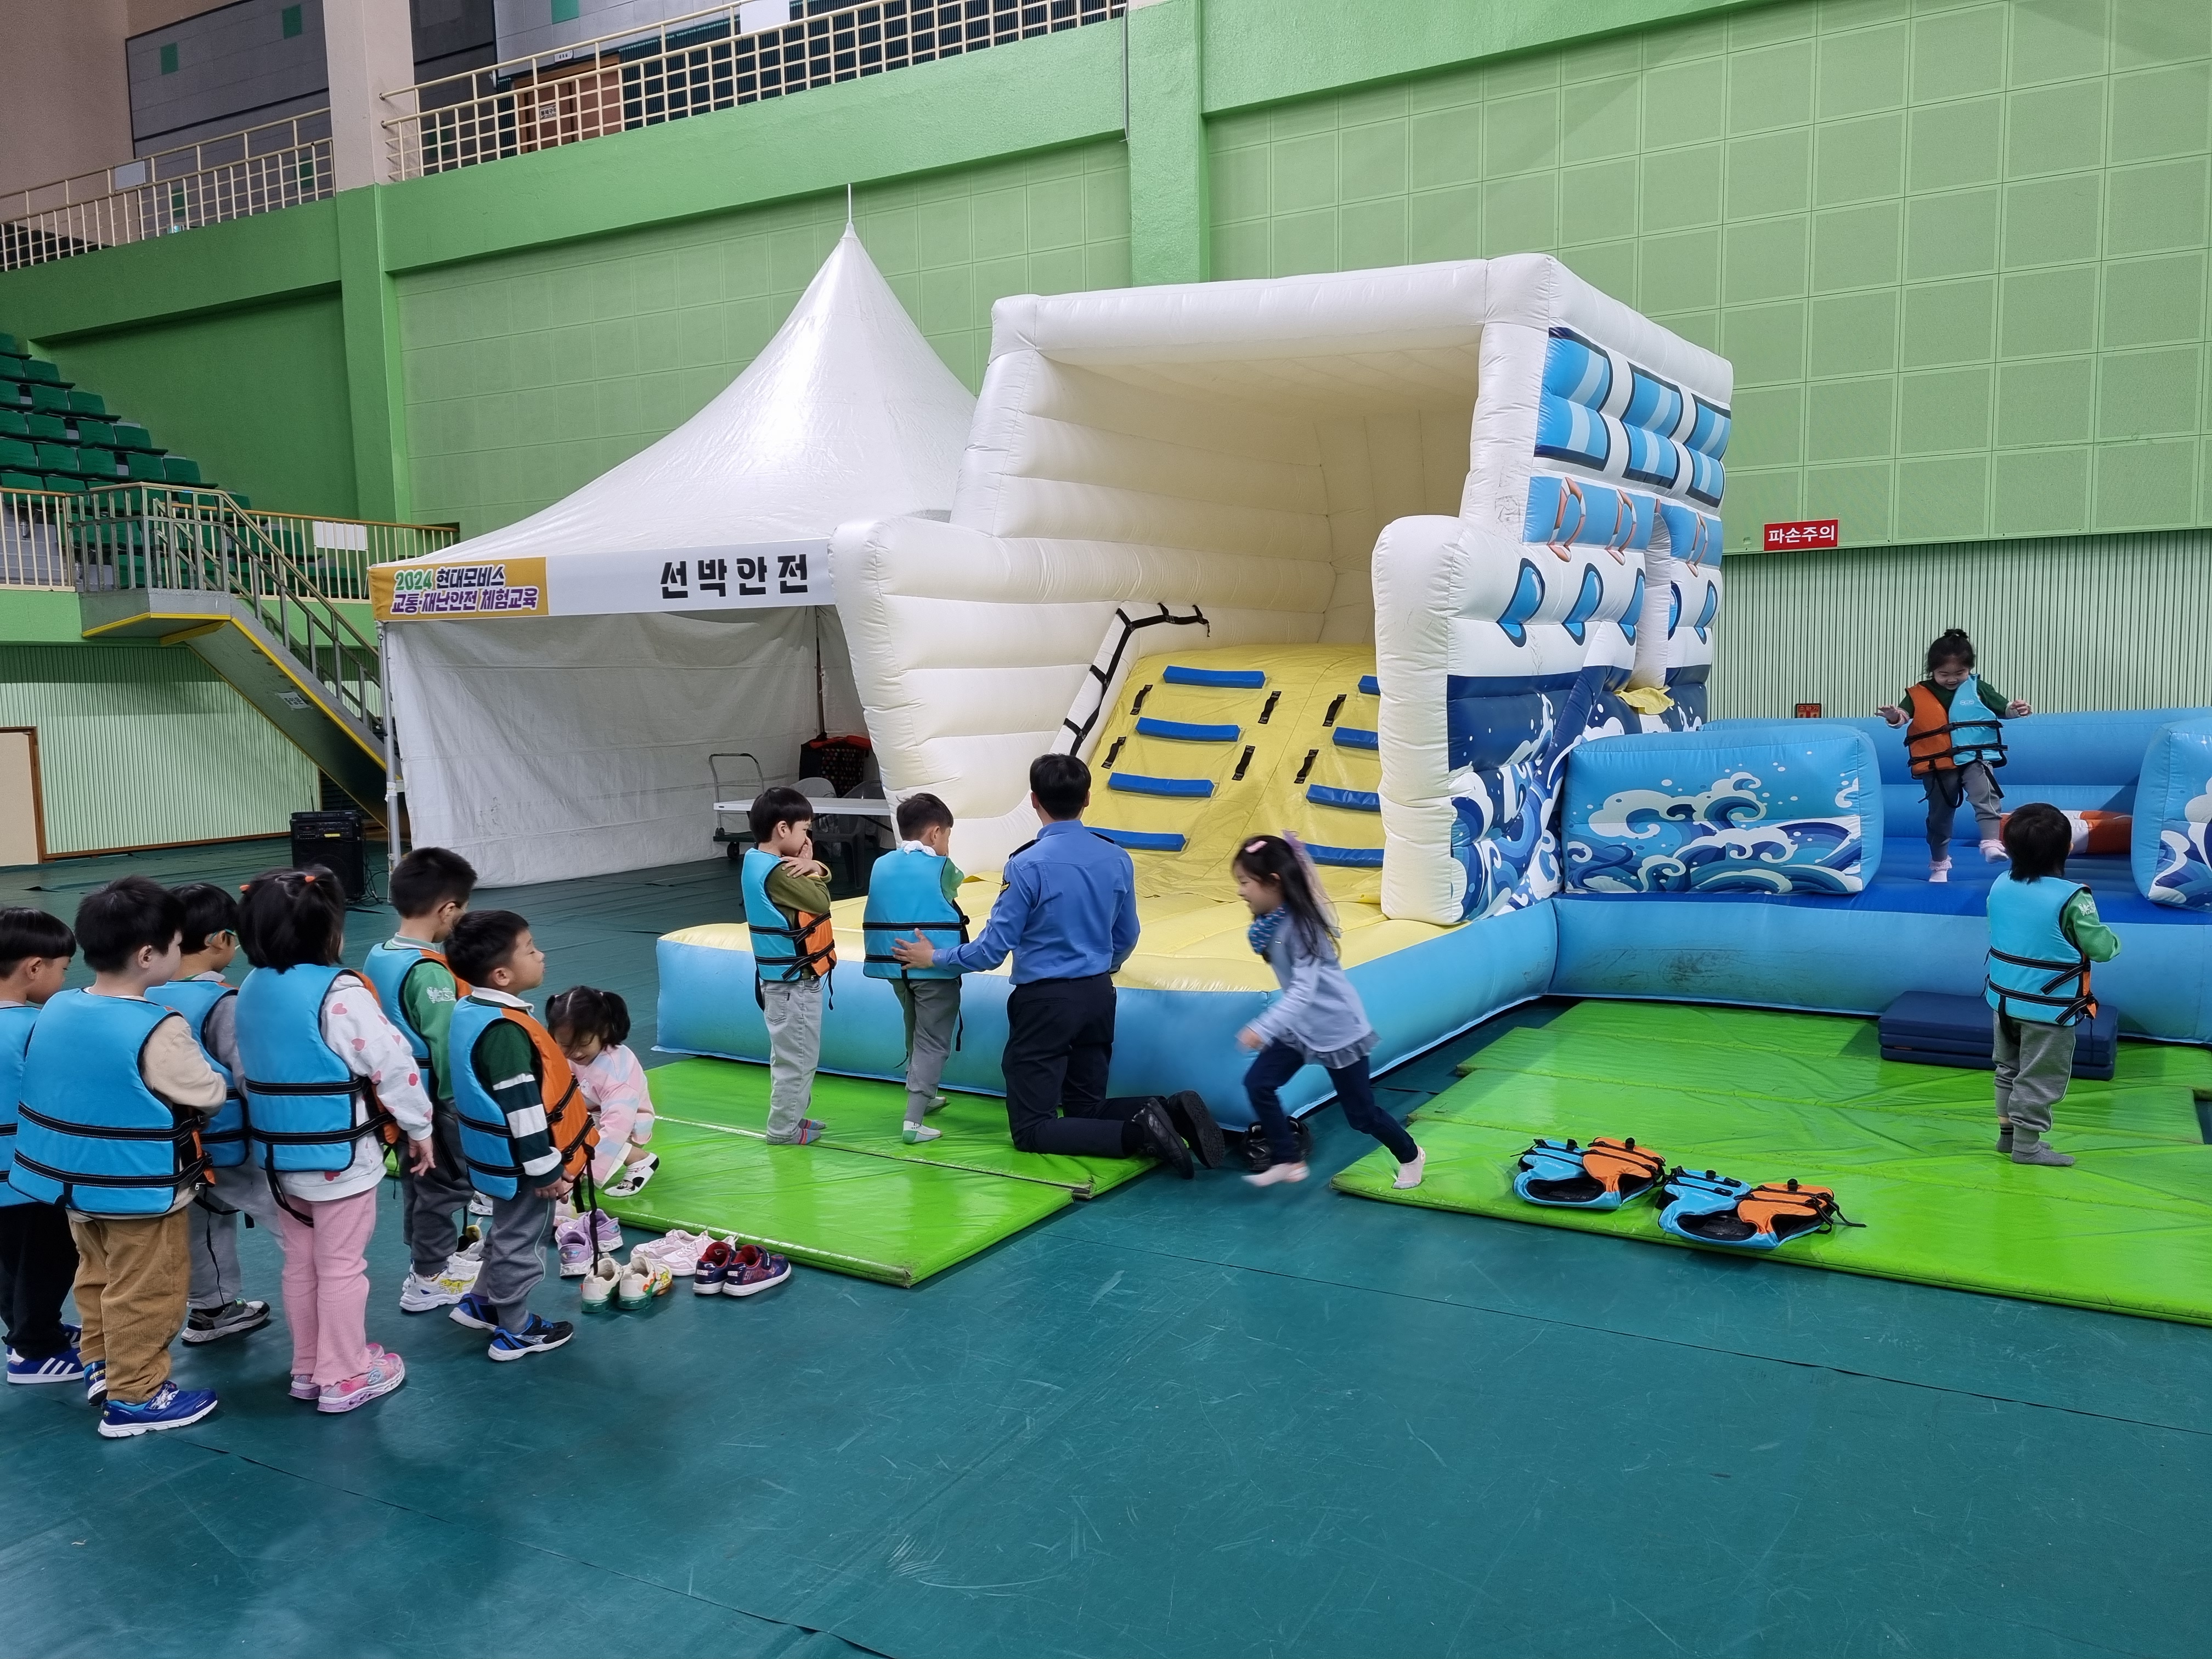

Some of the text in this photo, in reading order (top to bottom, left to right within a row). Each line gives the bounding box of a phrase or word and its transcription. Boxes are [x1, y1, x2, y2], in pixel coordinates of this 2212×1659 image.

[1768, 525, 1835, 544] 파손주의
[396, 566, 504, 591] 2024 현대모비스
[480, 588, 538, 610] 체험교육
